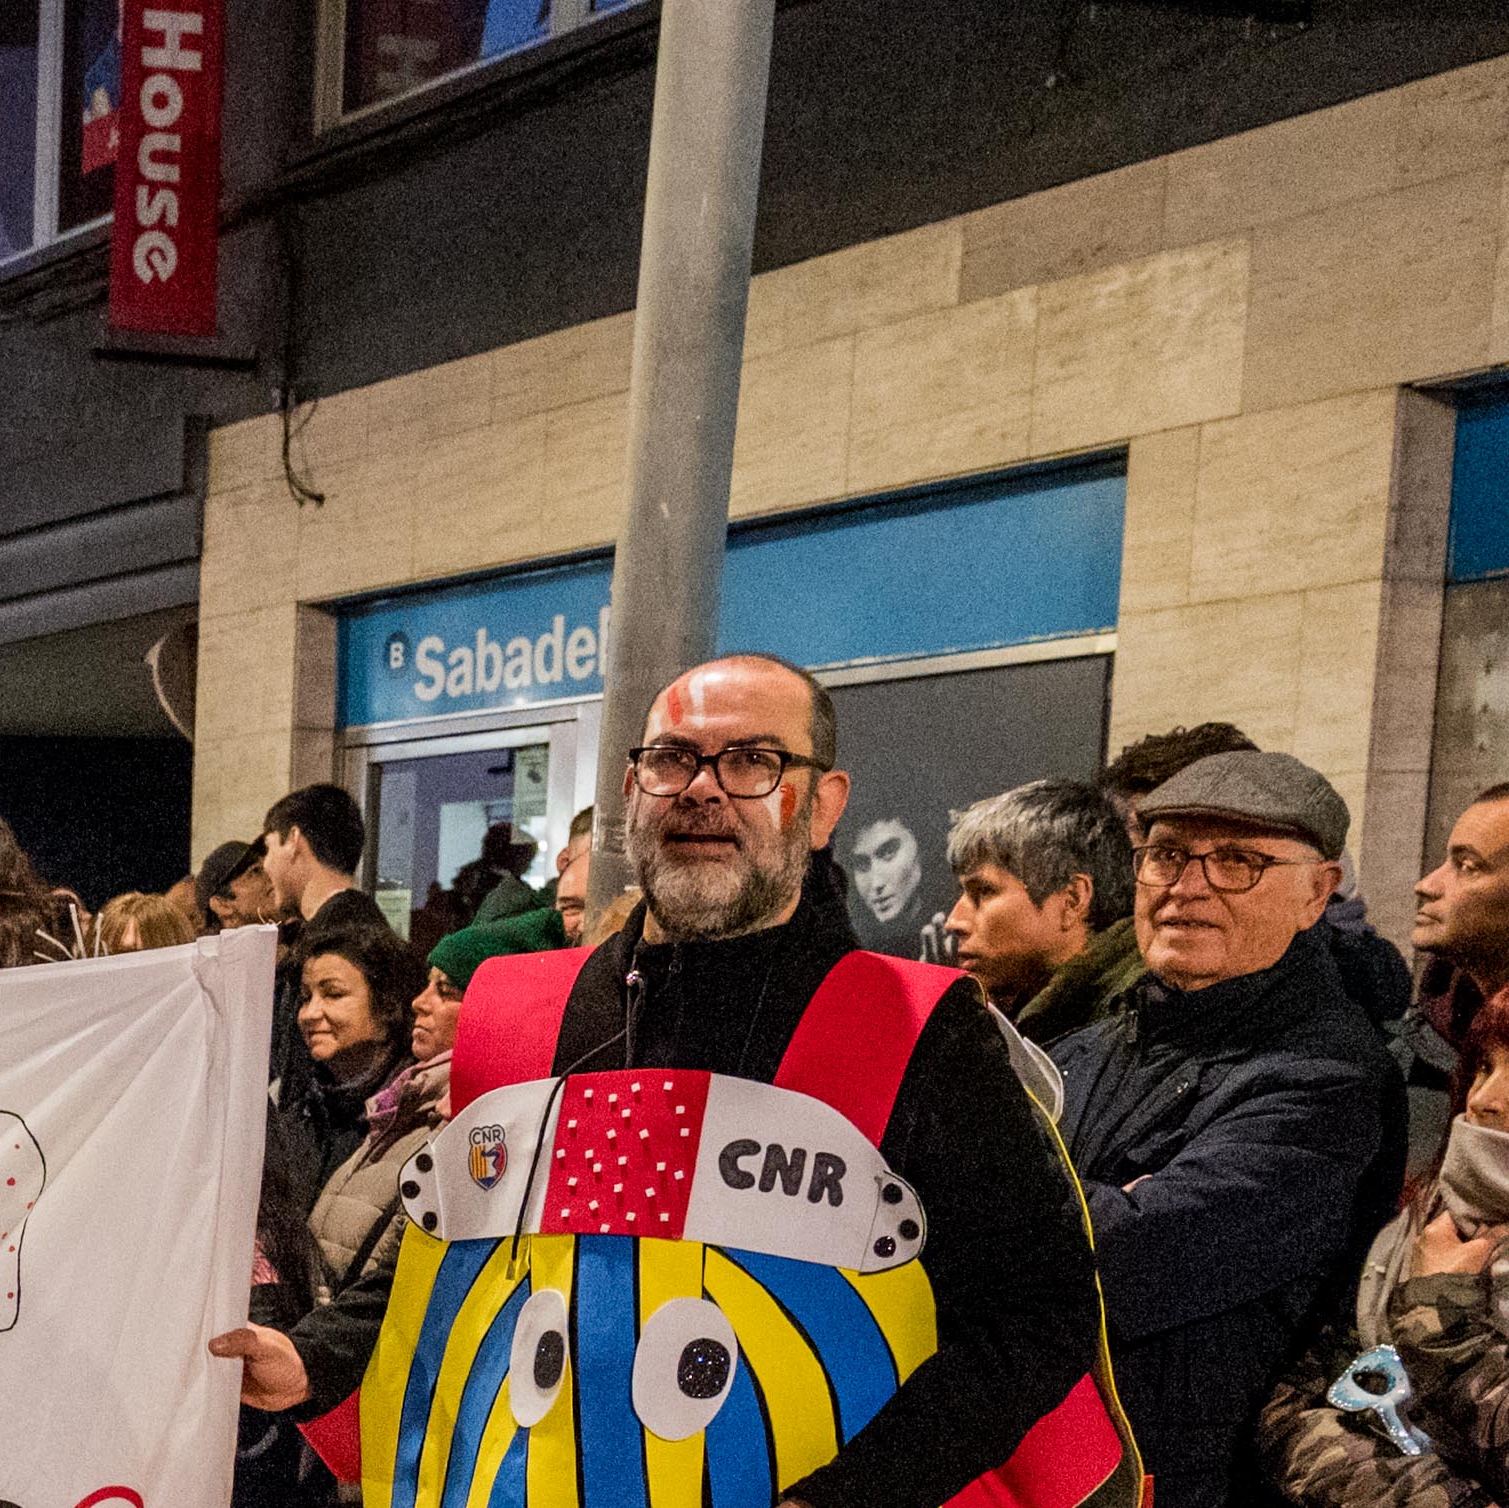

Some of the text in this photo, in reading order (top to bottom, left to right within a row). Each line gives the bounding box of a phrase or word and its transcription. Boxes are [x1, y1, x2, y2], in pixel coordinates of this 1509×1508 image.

[133, 10, 204, 284] House
[414, 607, 610, 702] Sabadel
[472, 1128, 502, 1145] CNR
[717, 1137, 848, 1208] CNR
